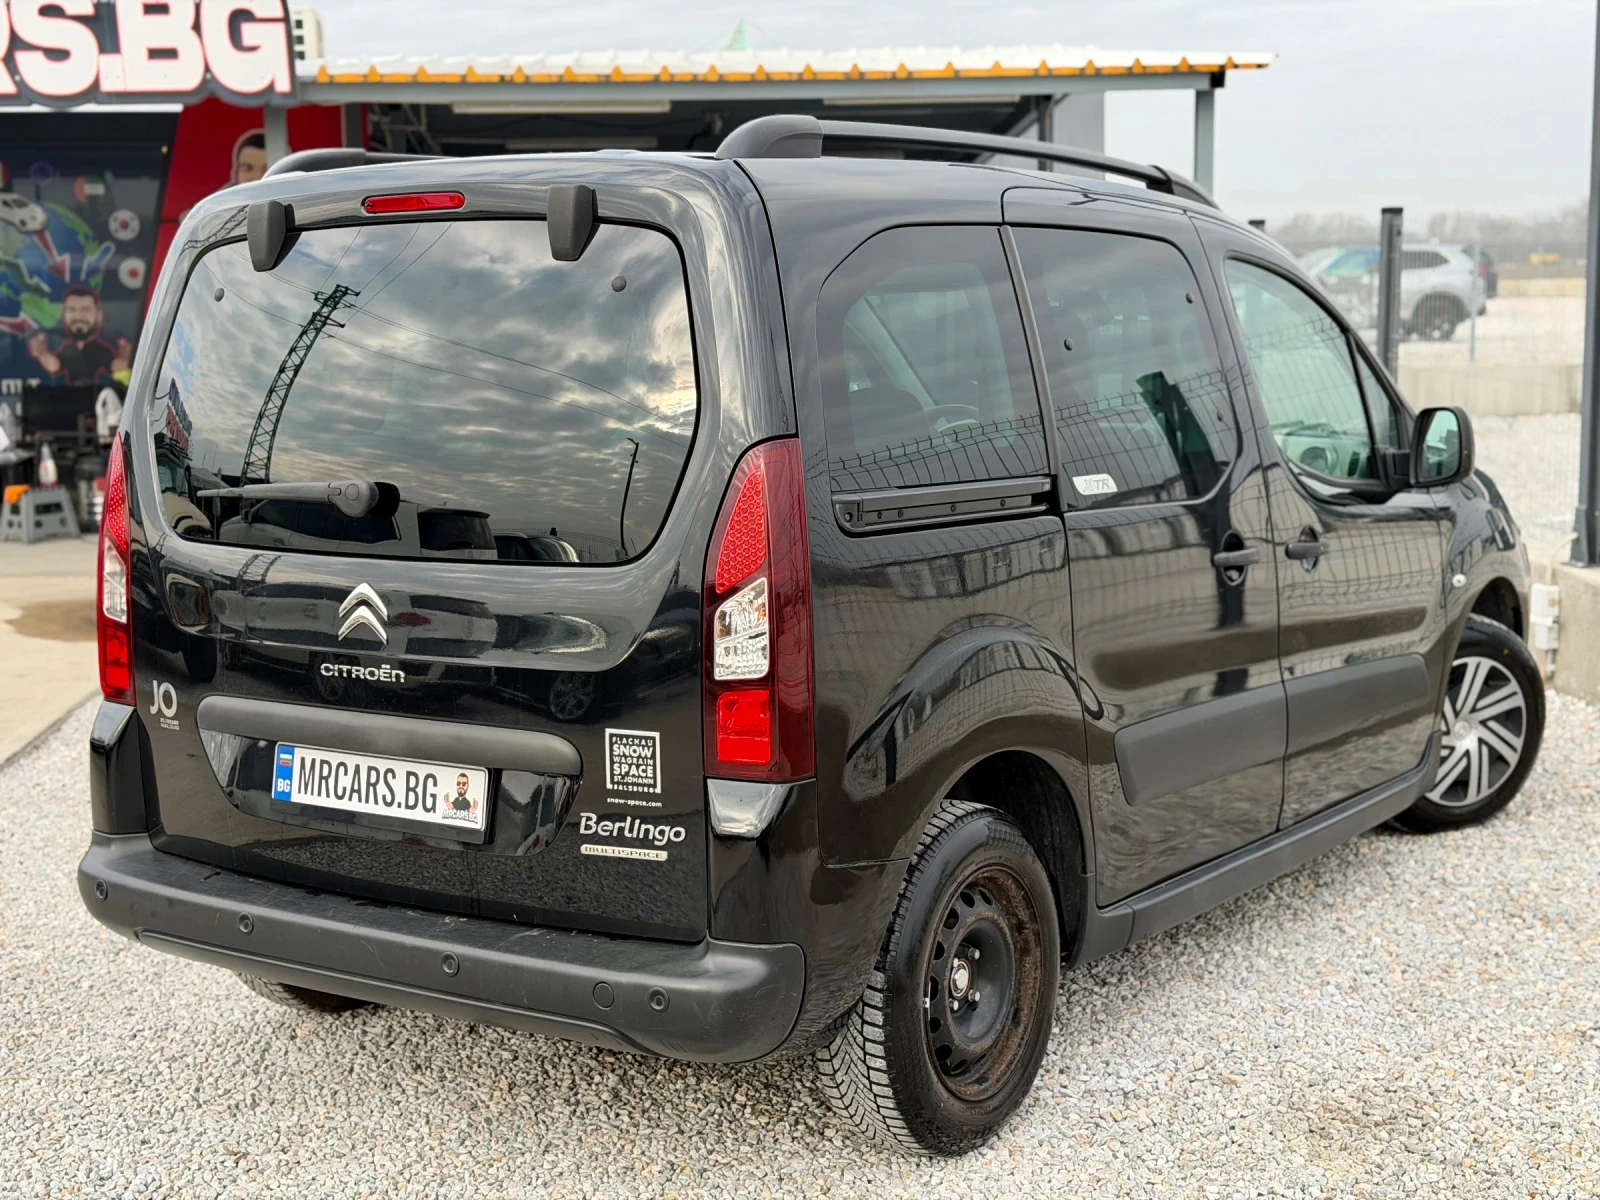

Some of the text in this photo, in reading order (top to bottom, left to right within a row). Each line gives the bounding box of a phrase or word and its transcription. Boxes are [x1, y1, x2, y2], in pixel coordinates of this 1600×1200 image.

[0, 0, 293, 97] S.BG
[1083, 478, 1110, 493] XTR
[149, 679, 178, 718] JO
[612, 737, 653, 746] FLACHAU
[612, 744, 653, 757] SNOW
[613, 757, 653, 765] WAGRAIN
[613, 763, 653, 777] SPACE
[276, 778, 291, 793] BG
[297, 755, 438, 814] MRCARS.BG
[614, 785, 654, 793] SALZBURG
[607, 798, 662, 808] snow-space.com
[579, 812, 686, 846] Berlingo
[584, 847, 663, 859] MULTISPACE
